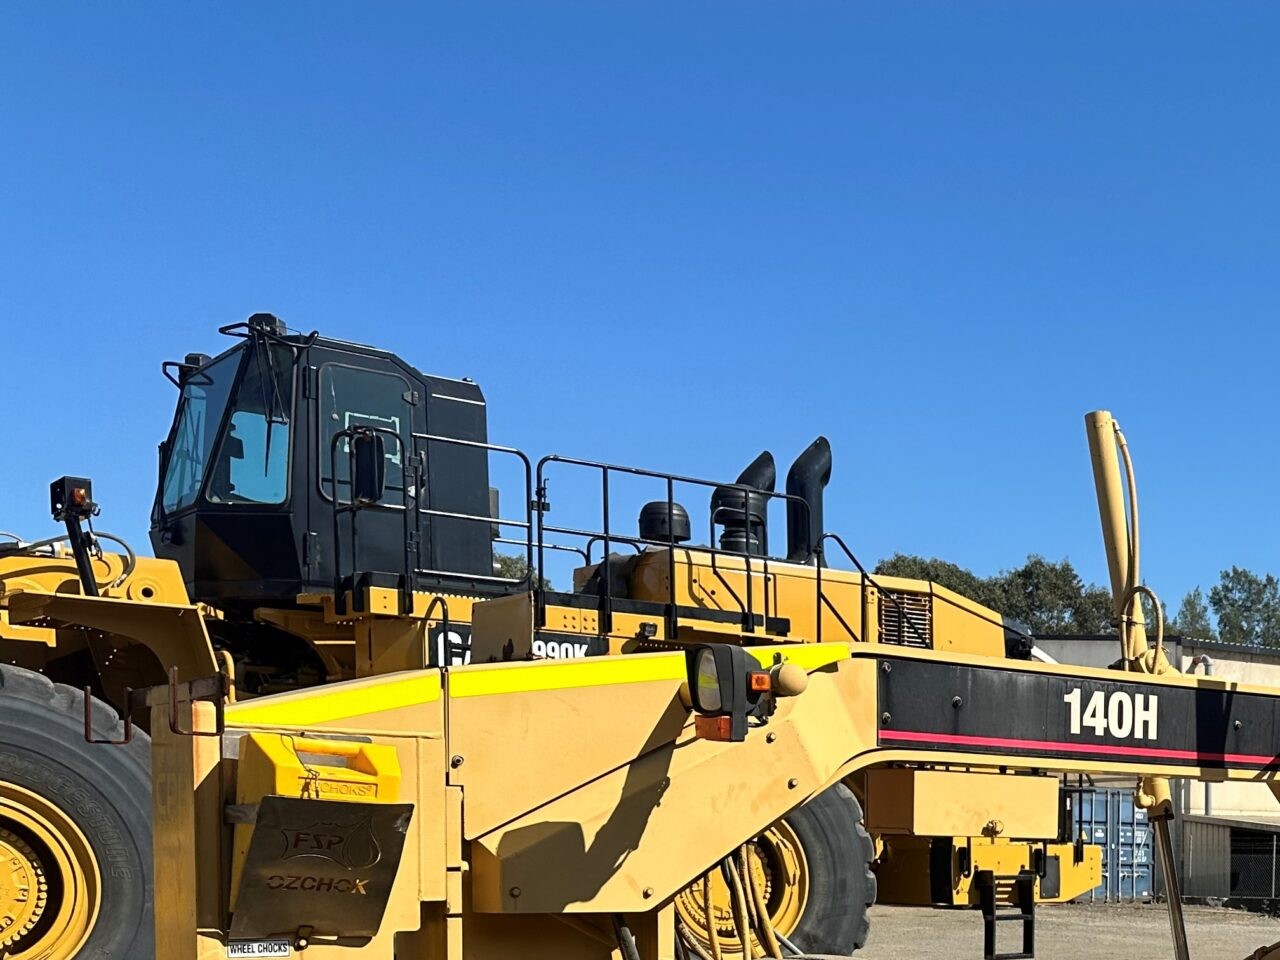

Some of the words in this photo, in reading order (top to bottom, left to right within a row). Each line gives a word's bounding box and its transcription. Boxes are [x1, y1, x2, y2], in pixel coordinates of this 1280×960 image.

[1063, 687, 1158, 740] 140H
[267, 875, 369, 895] OZCHOK
[230, 943, 256, 953] WHEEL
[257, 942, 288, 953] CHOCKS
